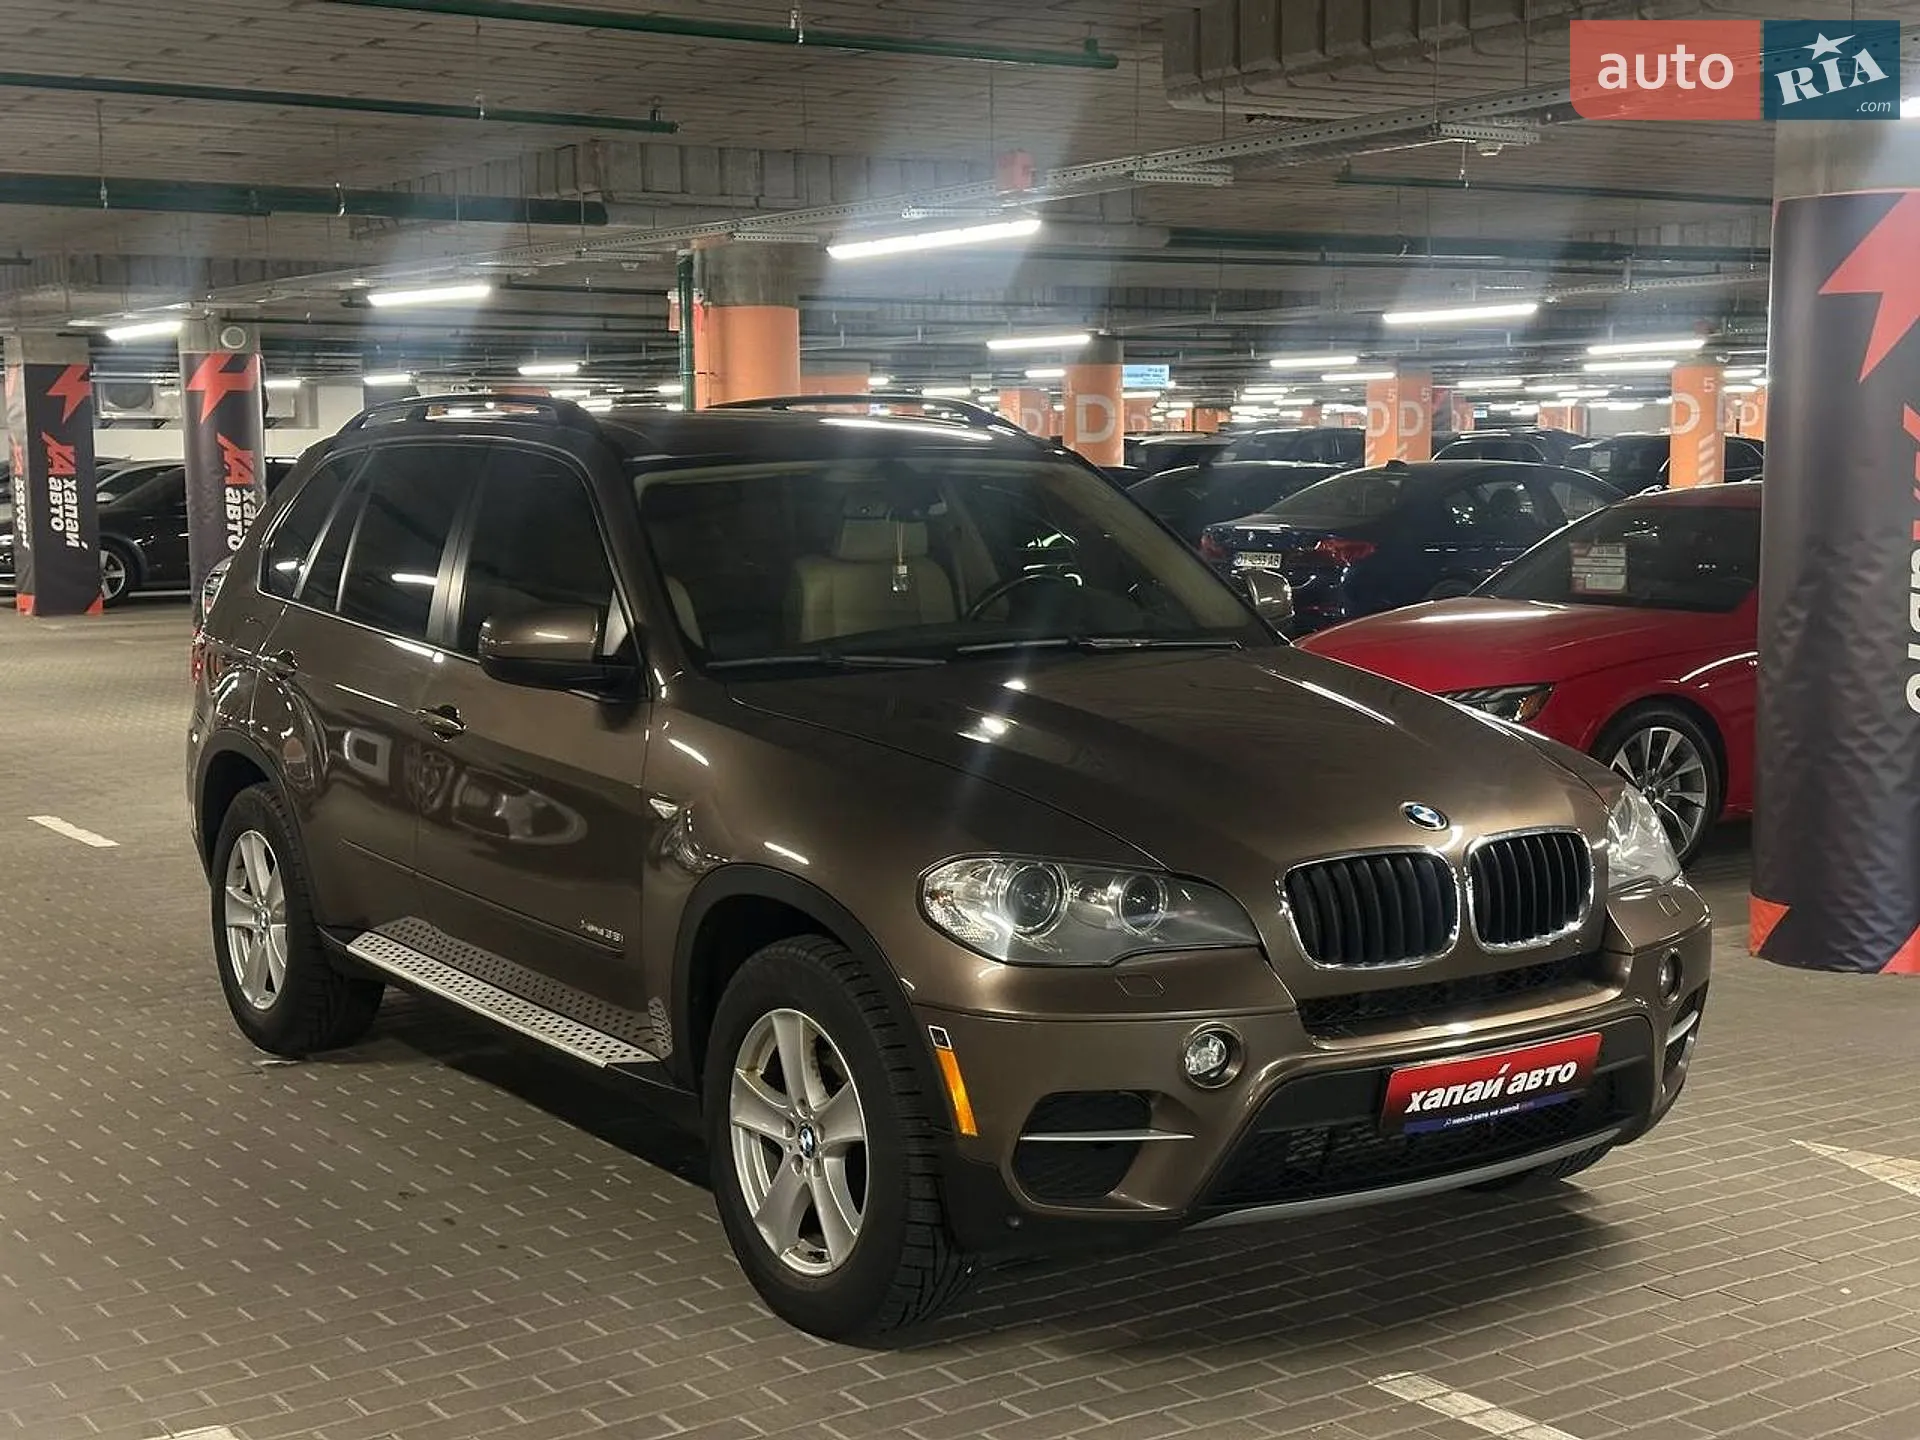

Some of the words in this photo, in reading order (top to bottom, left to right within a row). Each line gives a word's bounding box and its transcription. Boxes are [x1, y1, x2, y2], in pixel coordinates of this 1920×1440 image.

[1704, 377, 1716, 393] 5
[1076, 394, 1116, 443] D
[1367, 400, 1390, 437] D
[1398, 400, 1424, 437] D
[1671, 392, 1700, 435] D
[1740, 402, 1759, 427] D
[48, 477, 65, 531] авто
[63, 478, 89, 550] хапай
[225, 487, 243, 551] авто
[1404, 1063, 1511, 1114] хапай
[1506, 1061, 1578, 1095] авто
